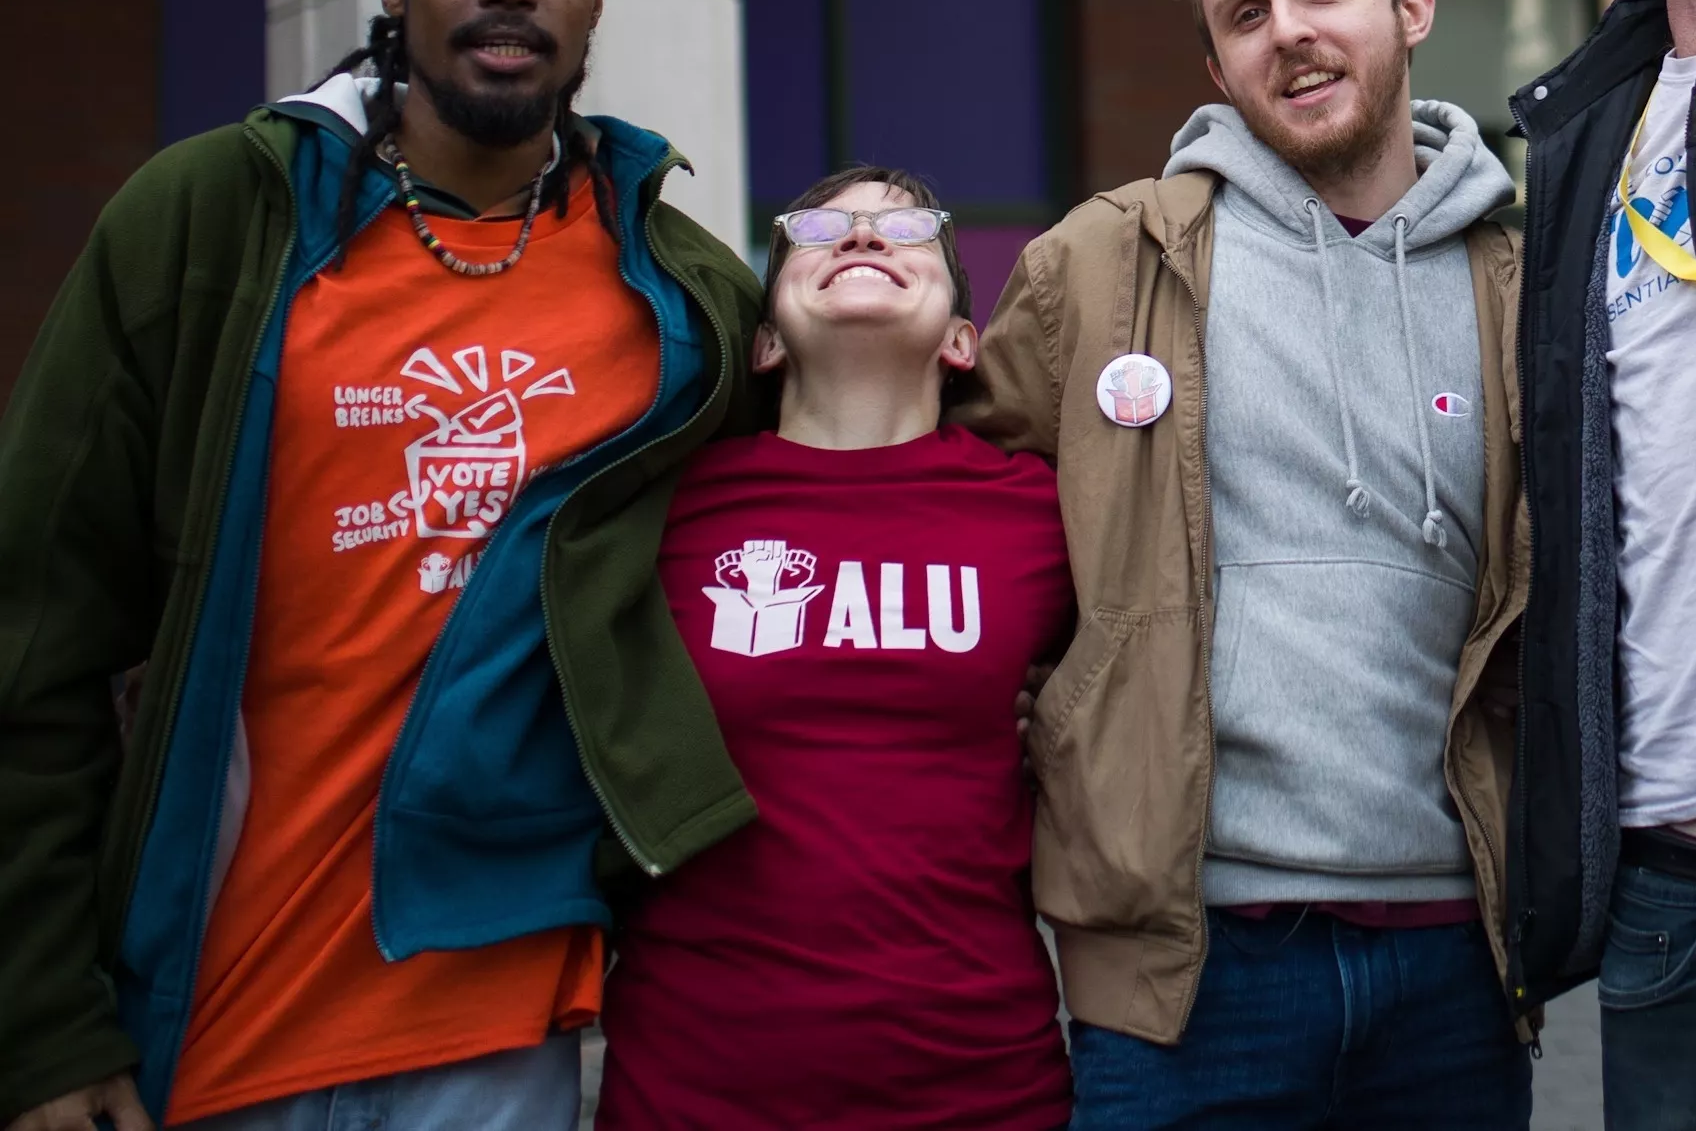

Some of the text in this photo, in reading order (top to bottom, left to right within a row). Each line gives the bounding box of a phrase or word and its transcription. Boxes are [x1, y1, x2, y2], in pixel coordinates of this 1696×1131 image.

[334, 385, 403, 406] LONGER
[335, 406, 404, 428] BREAKS
[427, 461, 512, 488] VOTE
[333, 501, 386, 528] JOB
[432, 490, 509, 526] YES
[332, 518, 410, 552] SECURITY
[822, 560, 982, 654] ALU
